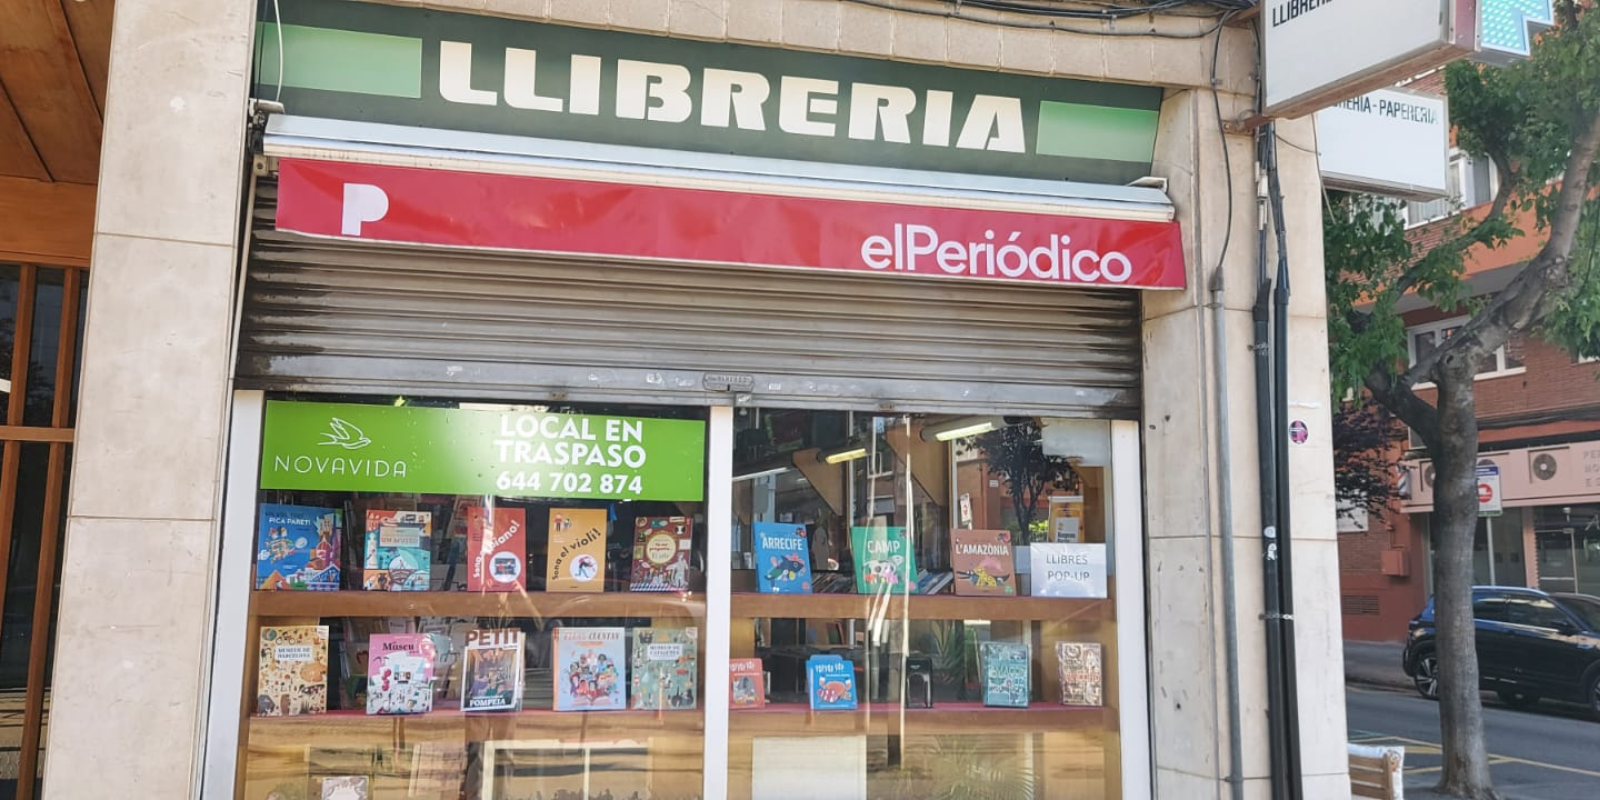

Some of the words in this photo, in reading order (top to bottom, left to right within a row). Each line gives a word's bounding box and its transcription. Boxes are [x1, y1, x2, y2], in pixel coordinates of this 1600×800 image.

[1272, 0, 1333, 27] LLIBRE
[439, 40, 1026, 153] LLIBRERIA
[342, 182, 389, 236] P
[861, 223, 1132, 283] elPeriódico
[501, 414, 596, 441] LOCAL
[605, 419, 643, 443] EN
[493, 440, 647, 468] TRASPASO
[274, 454, 407, 479] NOVAVIDA
[496, 471, 541, 491] 644
[549, 472, 592, 493] 702
[599, 475, 643, 494] 874
[762, 536, 804, 550] ARRECIFE
[867, 540, 900, 553] CAMP
[1046, 554, 1088, 565] LLIBRES
[1047, 570, 1090, 581] POP-UP
[465, 628, 521, 647] PETIT
[470, 697, 506, 707] POMPEIA
